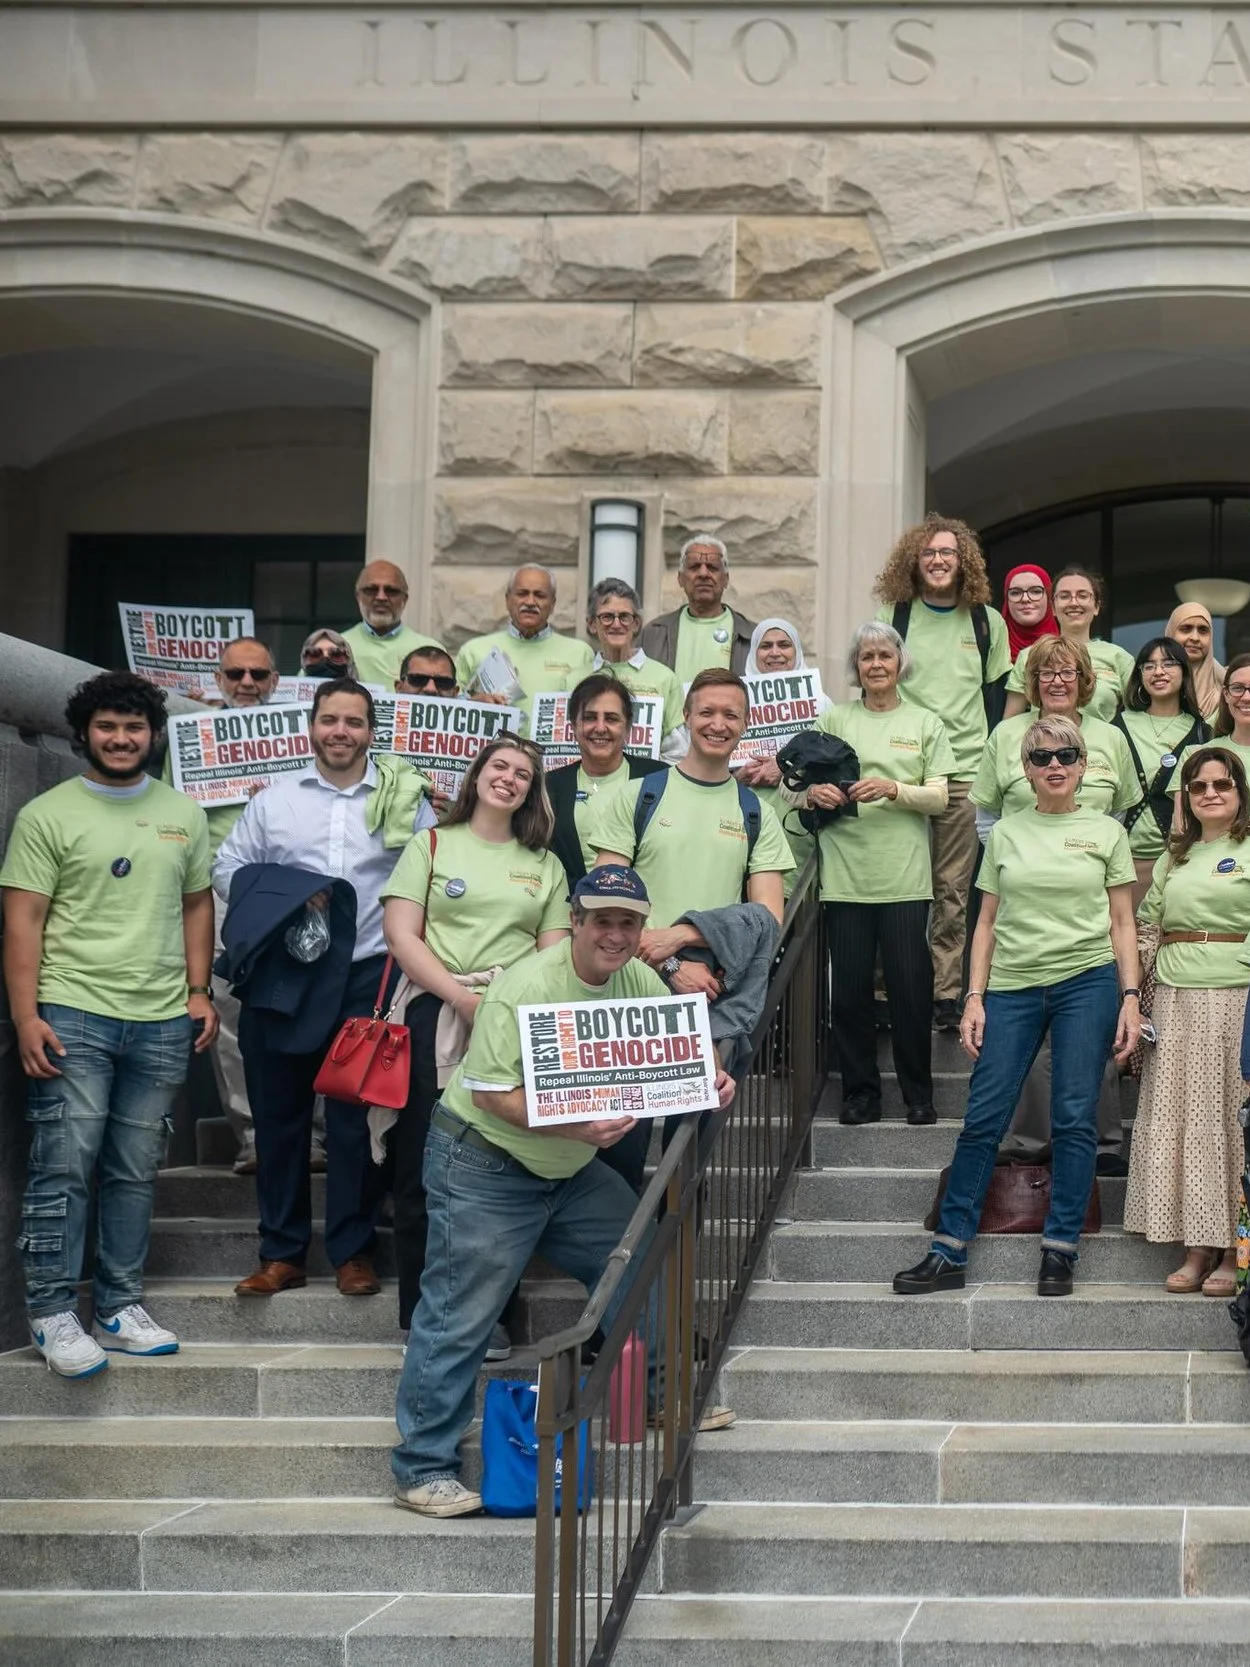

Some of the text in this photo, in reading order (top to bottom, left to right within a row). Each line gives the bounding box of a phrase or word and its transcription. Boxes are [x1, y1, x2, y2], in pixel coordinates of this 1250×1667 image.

[354, 20, 936, 87] ILLINOIS
[155, 612, 245, 638] BOYCOTT
[748, 675, 812, 702] YCOTT
[411, 702, 512, 737] BOYCOTT
[748, 699, 819, 726] NOCIDE
[756, 724, 801, 737] Anti-Boycott
[217, 735, 315, 764] GENOCID
[247, 762, 299, 773] Anti-Boycott
[575, 1002, 696, 1040] BOYCOTT
[529, 1012, 560, 1072] RESTORE
[558, 1010, 578, 1070] OUR RIGHT TO
[579, 1034, 704, 1068] GENOCIDE
[540, 1076, 574, 1087] Repeal
[576, 1073, 611, 1083] Illinois'
[615, 1069, 678, 1081] Anti-Boycott
[536, 1087, 620, 1104] THE ILLINOIS HUMAN
[537, 1099, 621, 1117] RIGHTS ADVOCACY ACT
[647, 1090, 680, 1100] Coalition
[648, 1095, 702, 1108] Human Rights
